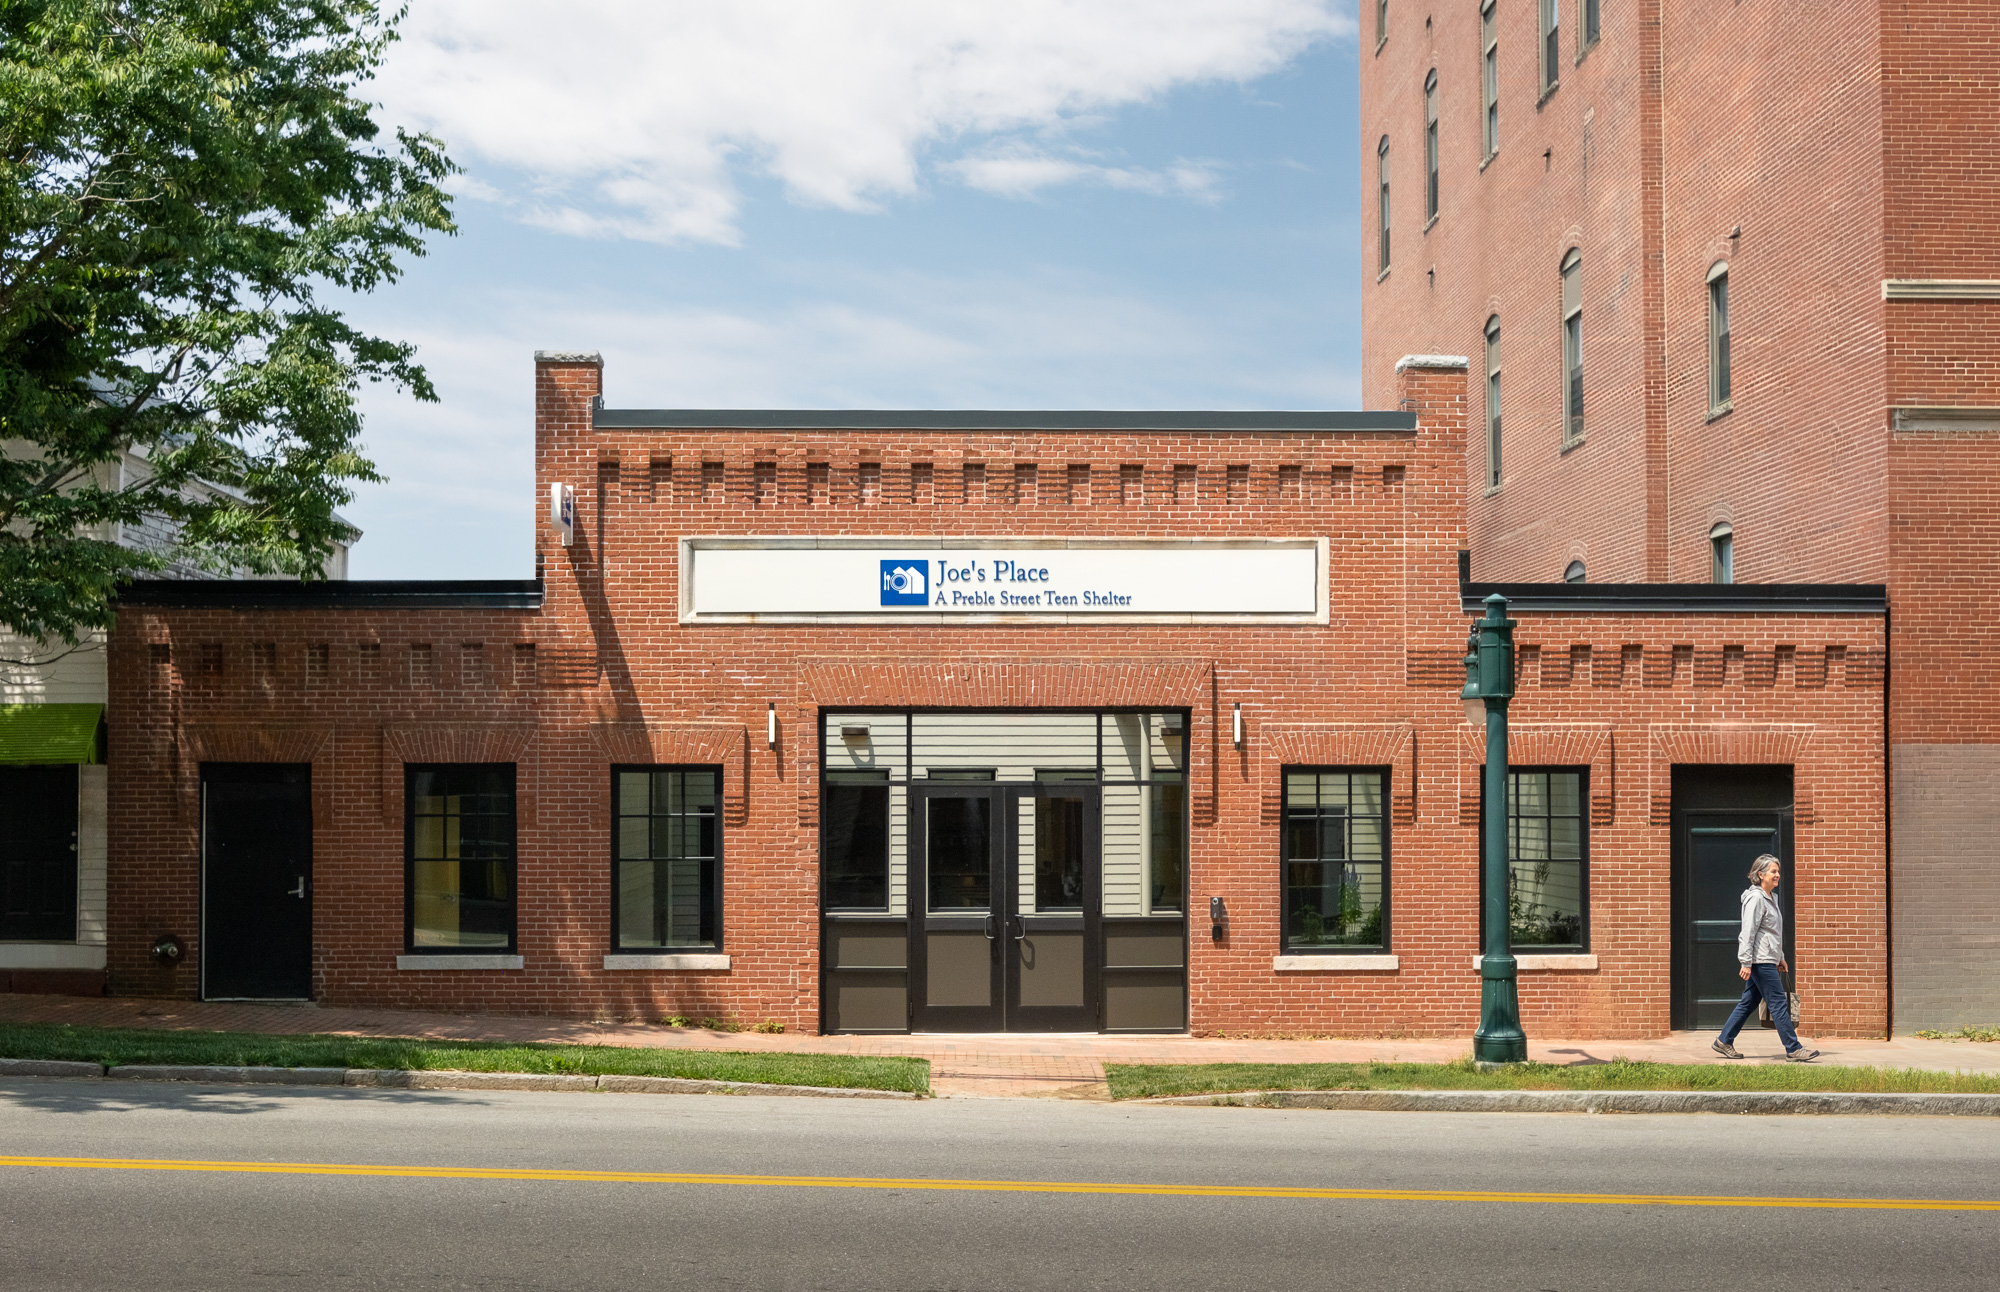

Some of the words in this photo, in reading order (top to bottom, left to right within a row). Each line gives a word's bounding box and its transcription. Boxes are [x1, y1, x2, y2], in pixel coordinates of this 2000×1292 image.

[936, 560, 986, 587] Joe's
[994, 560, 1049, 582] Place
[935, 591, 947, 605] A
[952, 591, 995, 605] Preble
[1000, 591, 1040, 605] Street
[1044, 591, 1078, 605] Teen
[1083, 591, 1132, 605] Shelter
